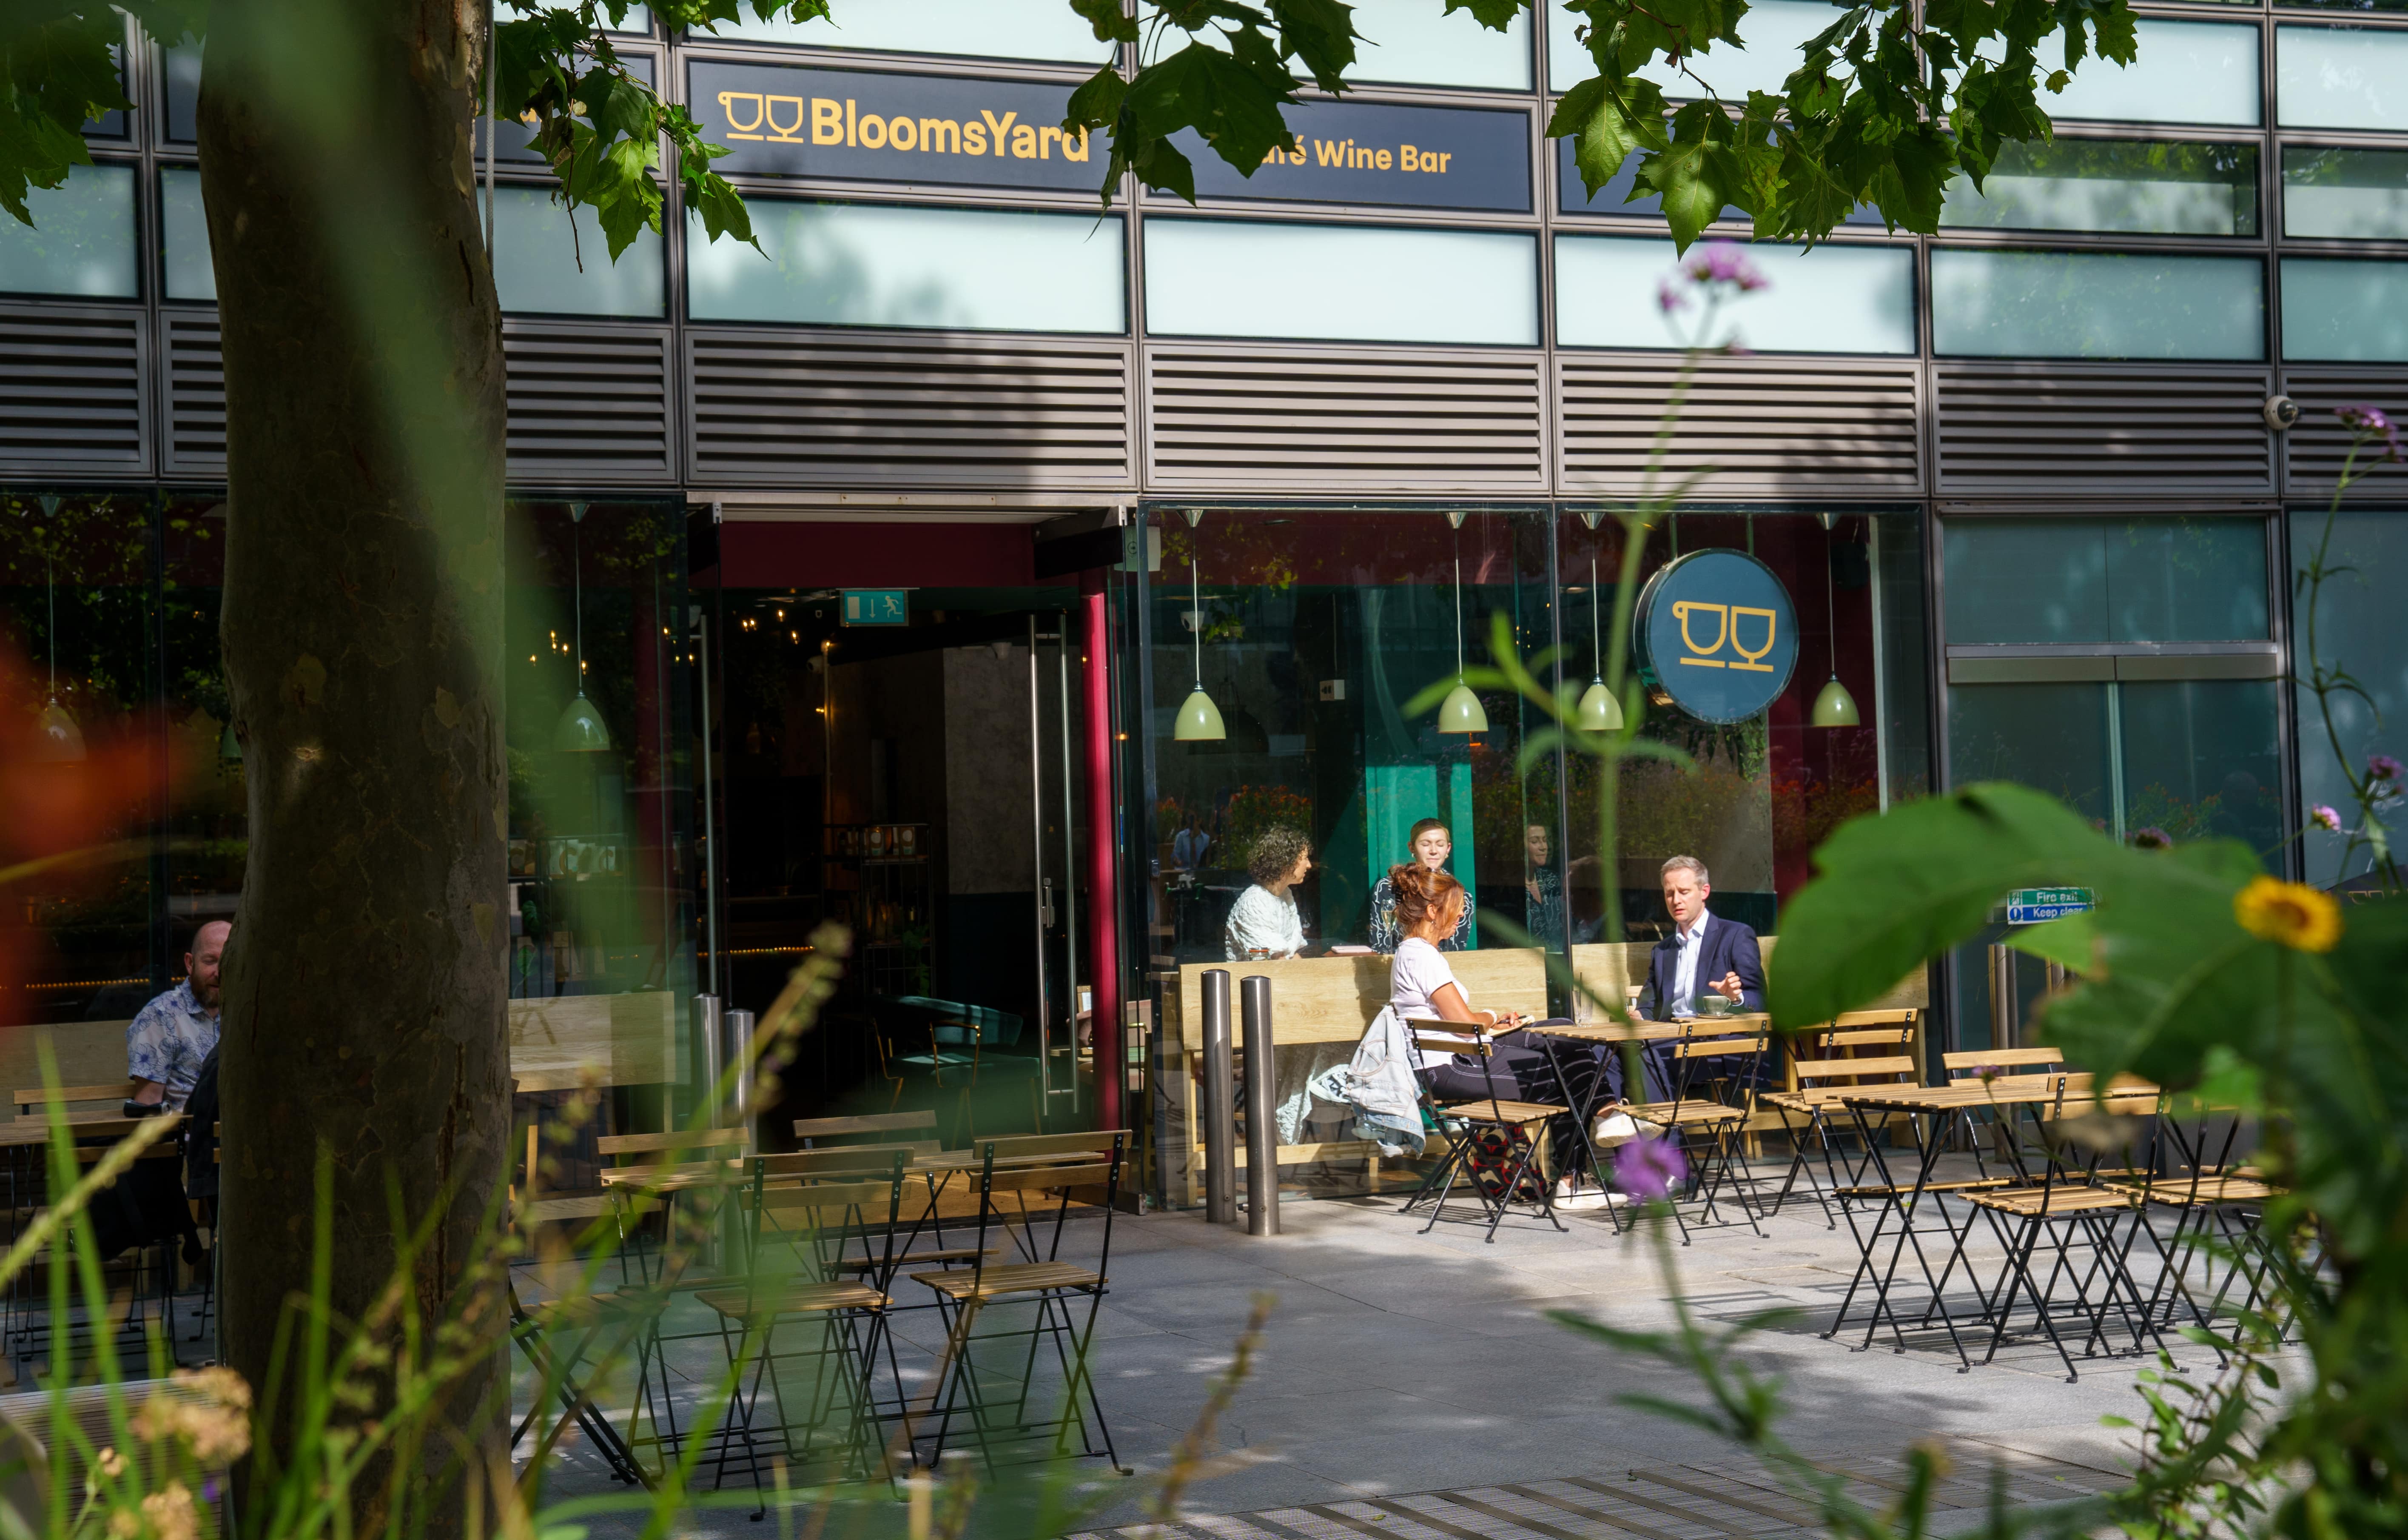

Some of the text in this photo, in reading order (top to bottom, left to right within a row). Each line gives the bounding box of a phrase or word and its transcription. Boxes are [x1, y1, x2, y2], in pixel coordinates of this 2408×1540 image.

[811, 97, 1089, 162] BloomsYard
[1314, 139, 1392, 170] Wine
[1400, 144, 1452, 173] Bar
[2036, 891, 2078, 903] Fire exit
[2033, 906, 2084, 918] Keep clear
